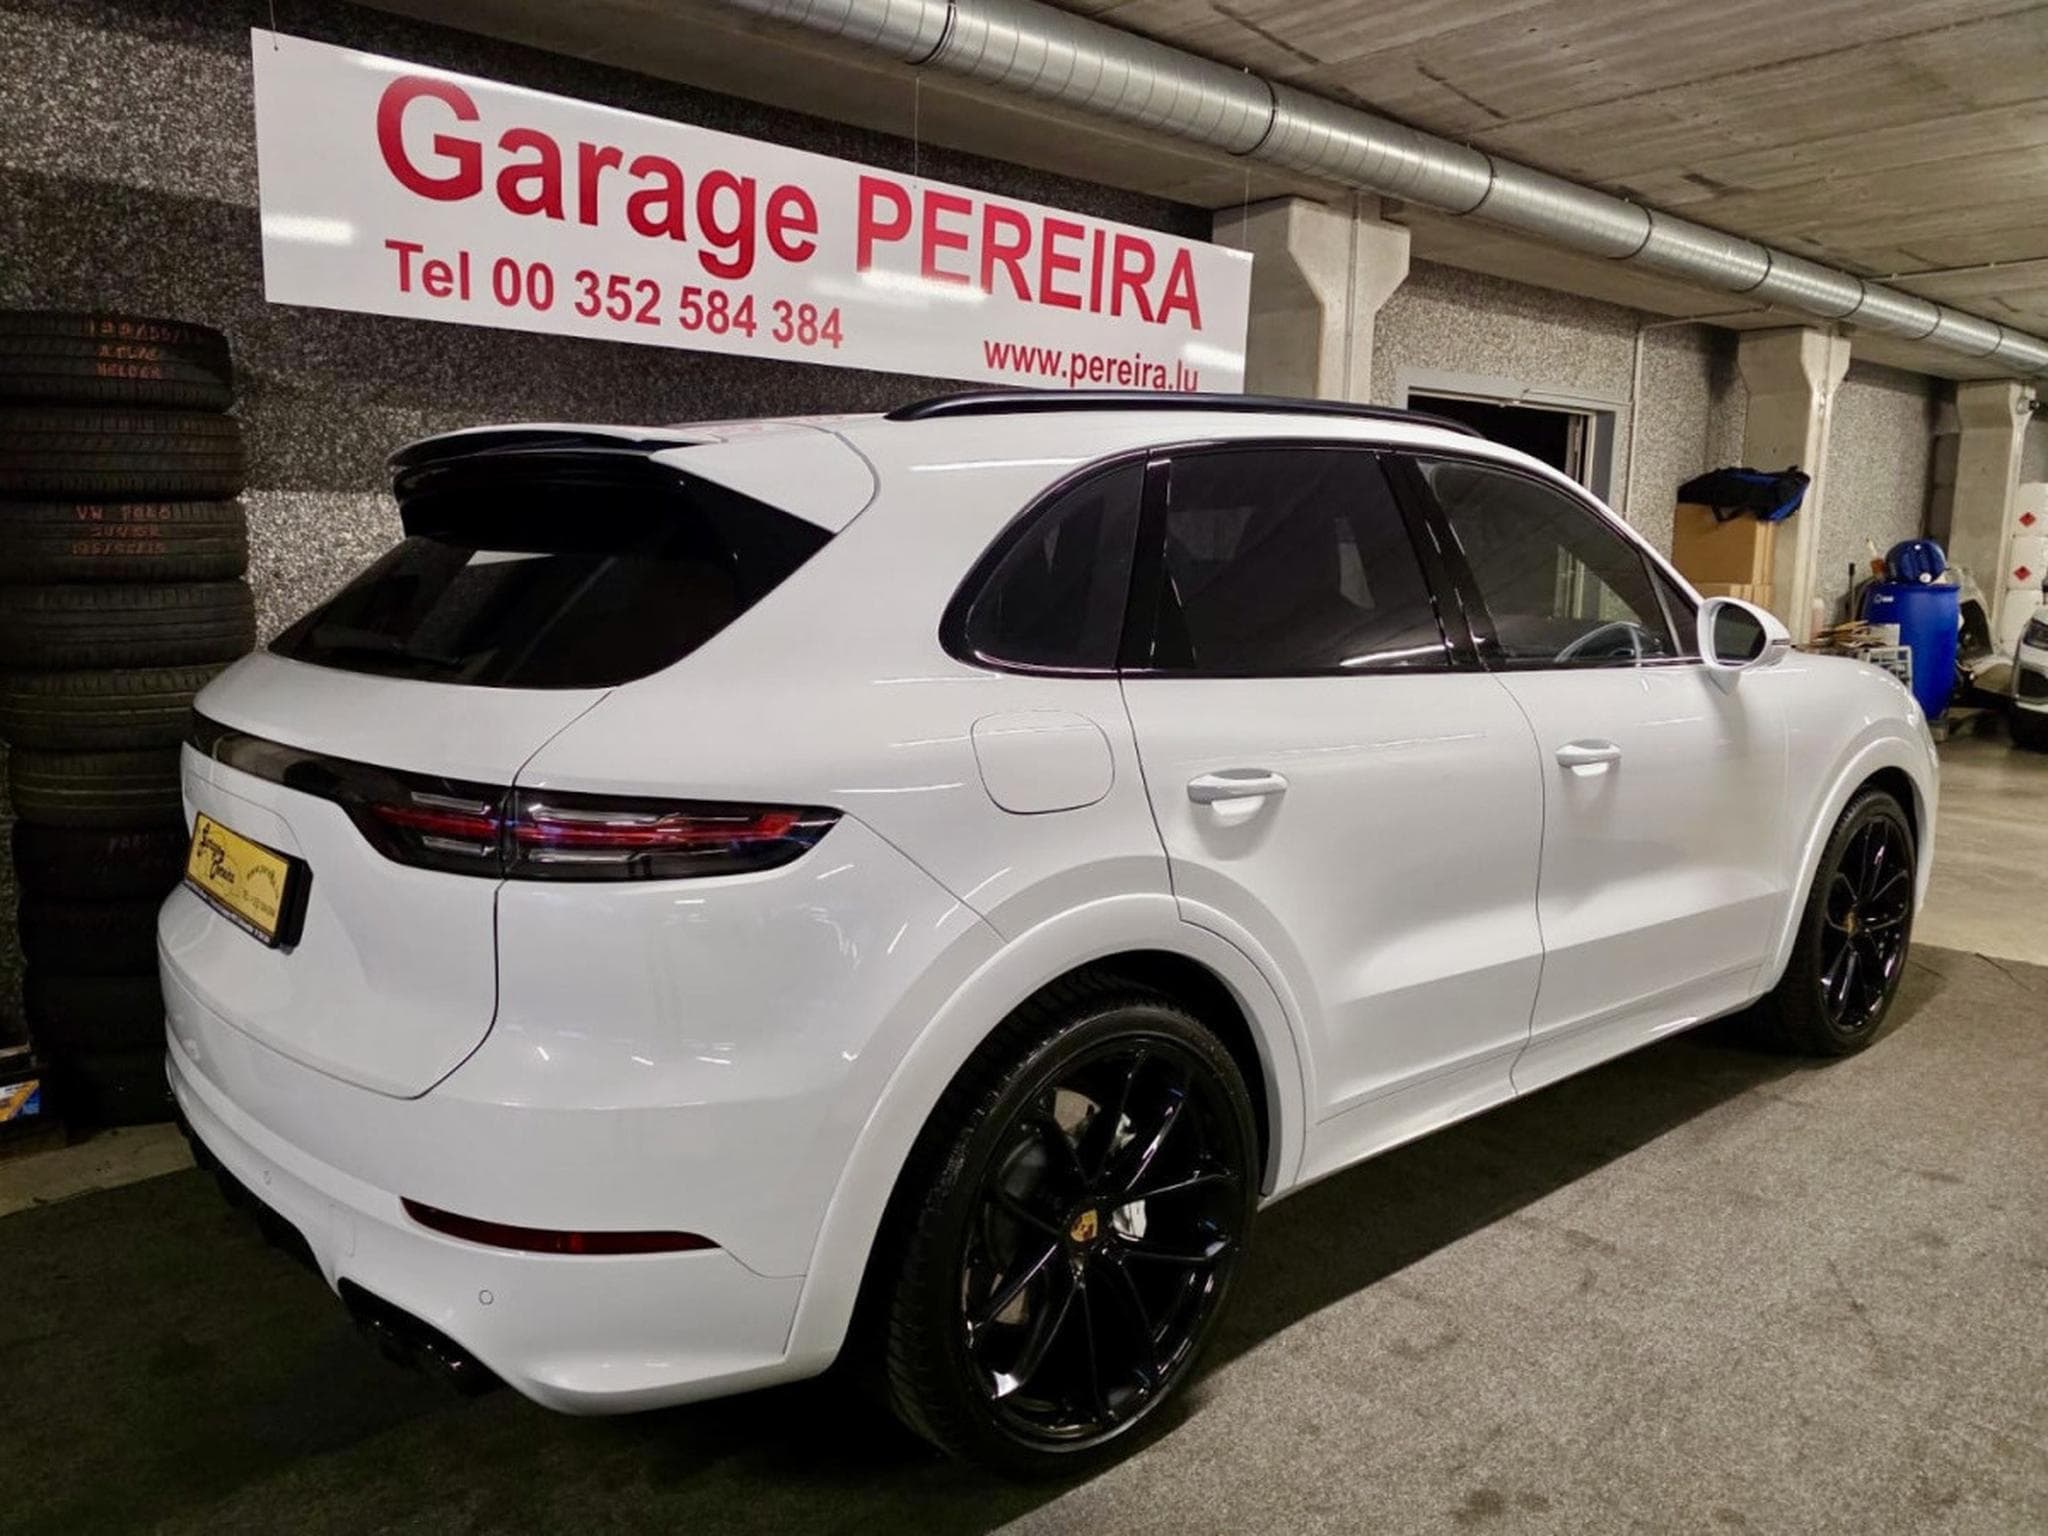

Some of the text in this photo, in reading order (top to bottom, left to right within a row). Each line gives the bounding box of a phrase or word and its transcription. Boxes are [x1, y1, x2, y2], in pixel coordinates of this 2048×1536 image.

[376, 75, 1202, 331] Garage PEREIRA
[385, 239, 843, 348] Tel 00 352 584 384
[984, 341, 1199, 391] www.pereira.lu
